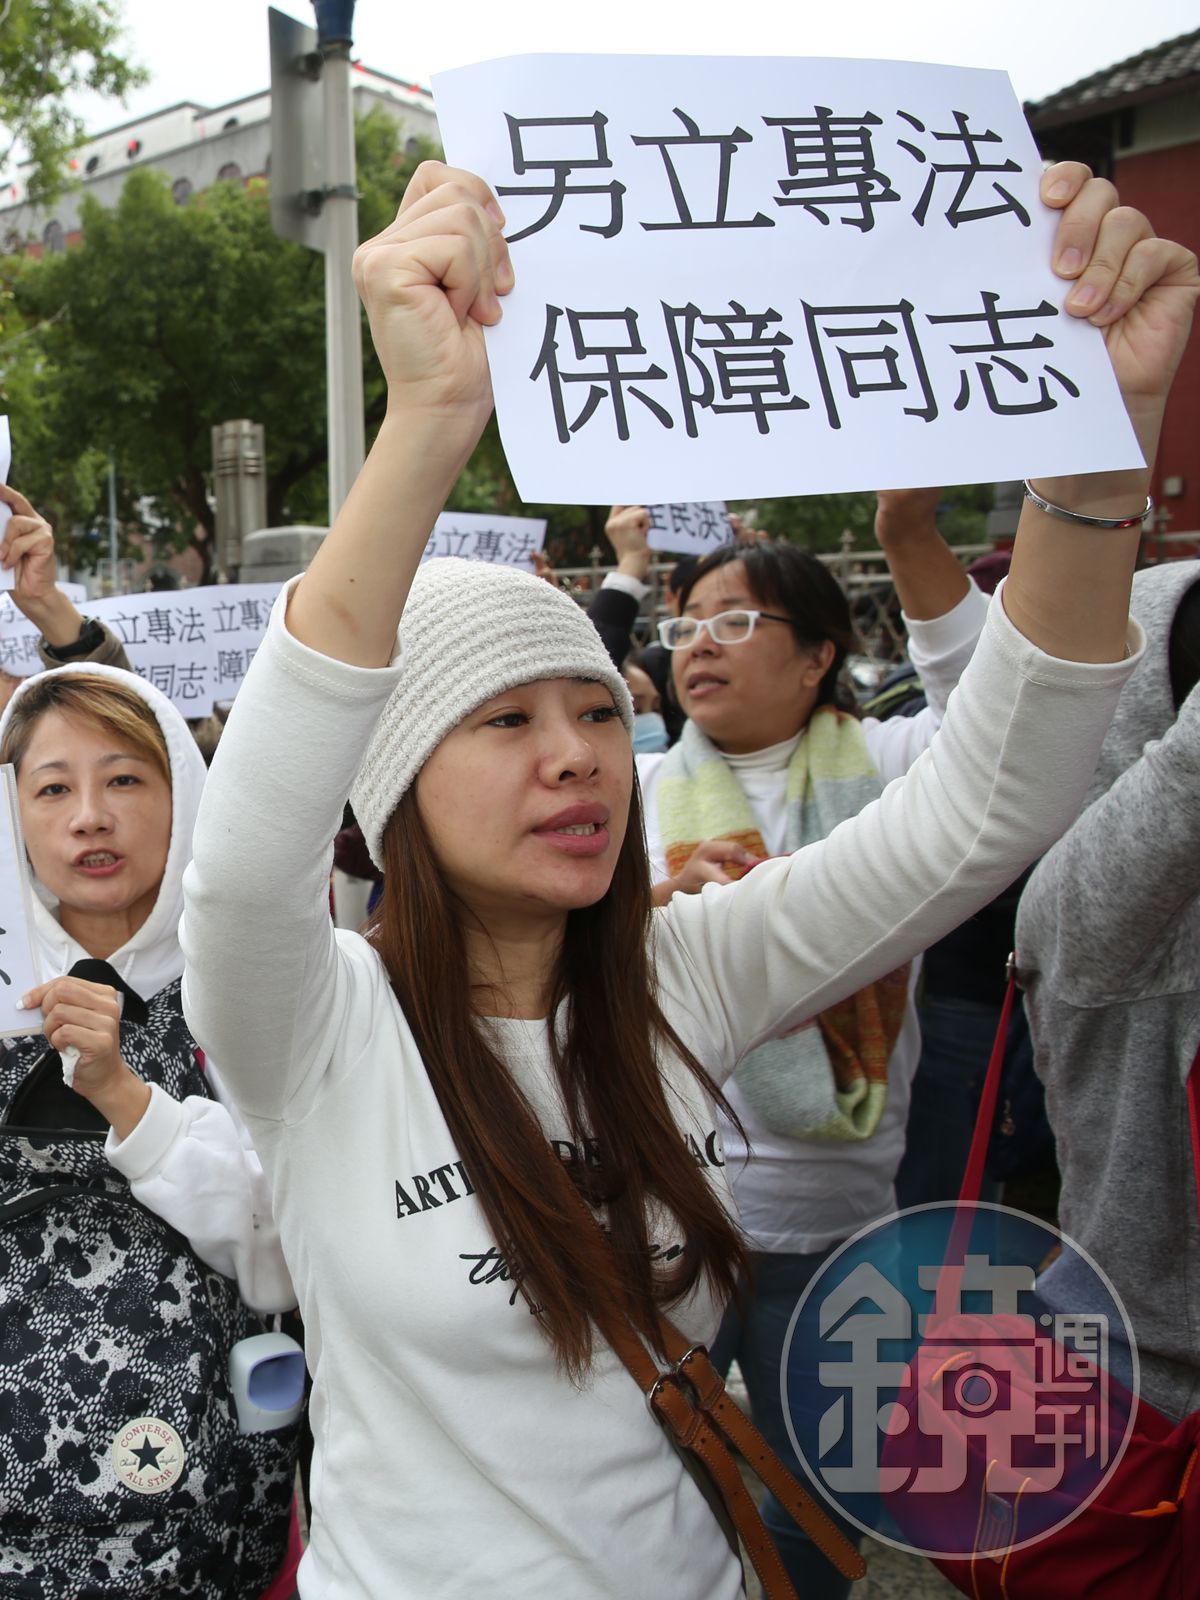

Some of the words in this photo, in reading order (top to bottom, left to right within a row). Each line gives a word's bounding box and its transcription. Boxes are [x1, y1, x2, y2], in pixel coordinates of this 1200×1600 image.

[495, 105, 1031, 243] 另立專法
[530, 291, 1080, 443] 保障同志
[121, 1424, 173, 1448] CONVERSE
[126, 1471, 144, 1487] ALL
[147, 1469, 173, 1487] STAR
